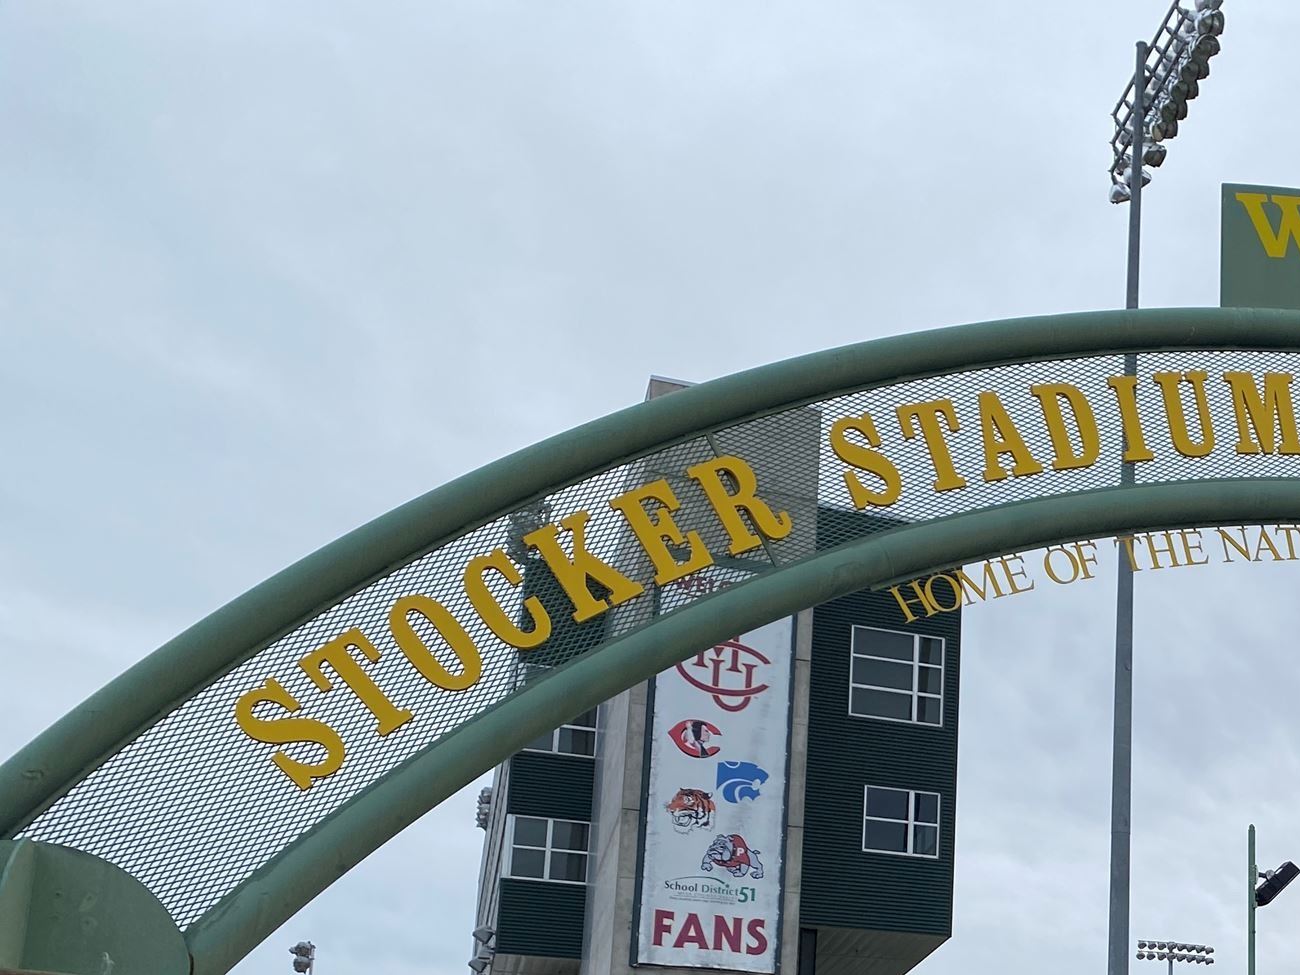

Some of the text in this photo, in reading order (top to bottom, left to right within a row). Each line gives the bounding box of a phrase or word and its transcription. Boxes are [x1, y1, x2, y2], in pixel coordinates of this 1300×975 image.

[888, 553, 1035, 625] HOME
[1043, 541, 1098, 586] OF
[1114, 529, 1209, 573] THE
[235, 454, 792, 791] STOCKER
[664, 880, 698, 892] School
[701, 884, 739, 897] District
[738, 886, 756, 903] 51
[652, 908, 768, 956] FANS
